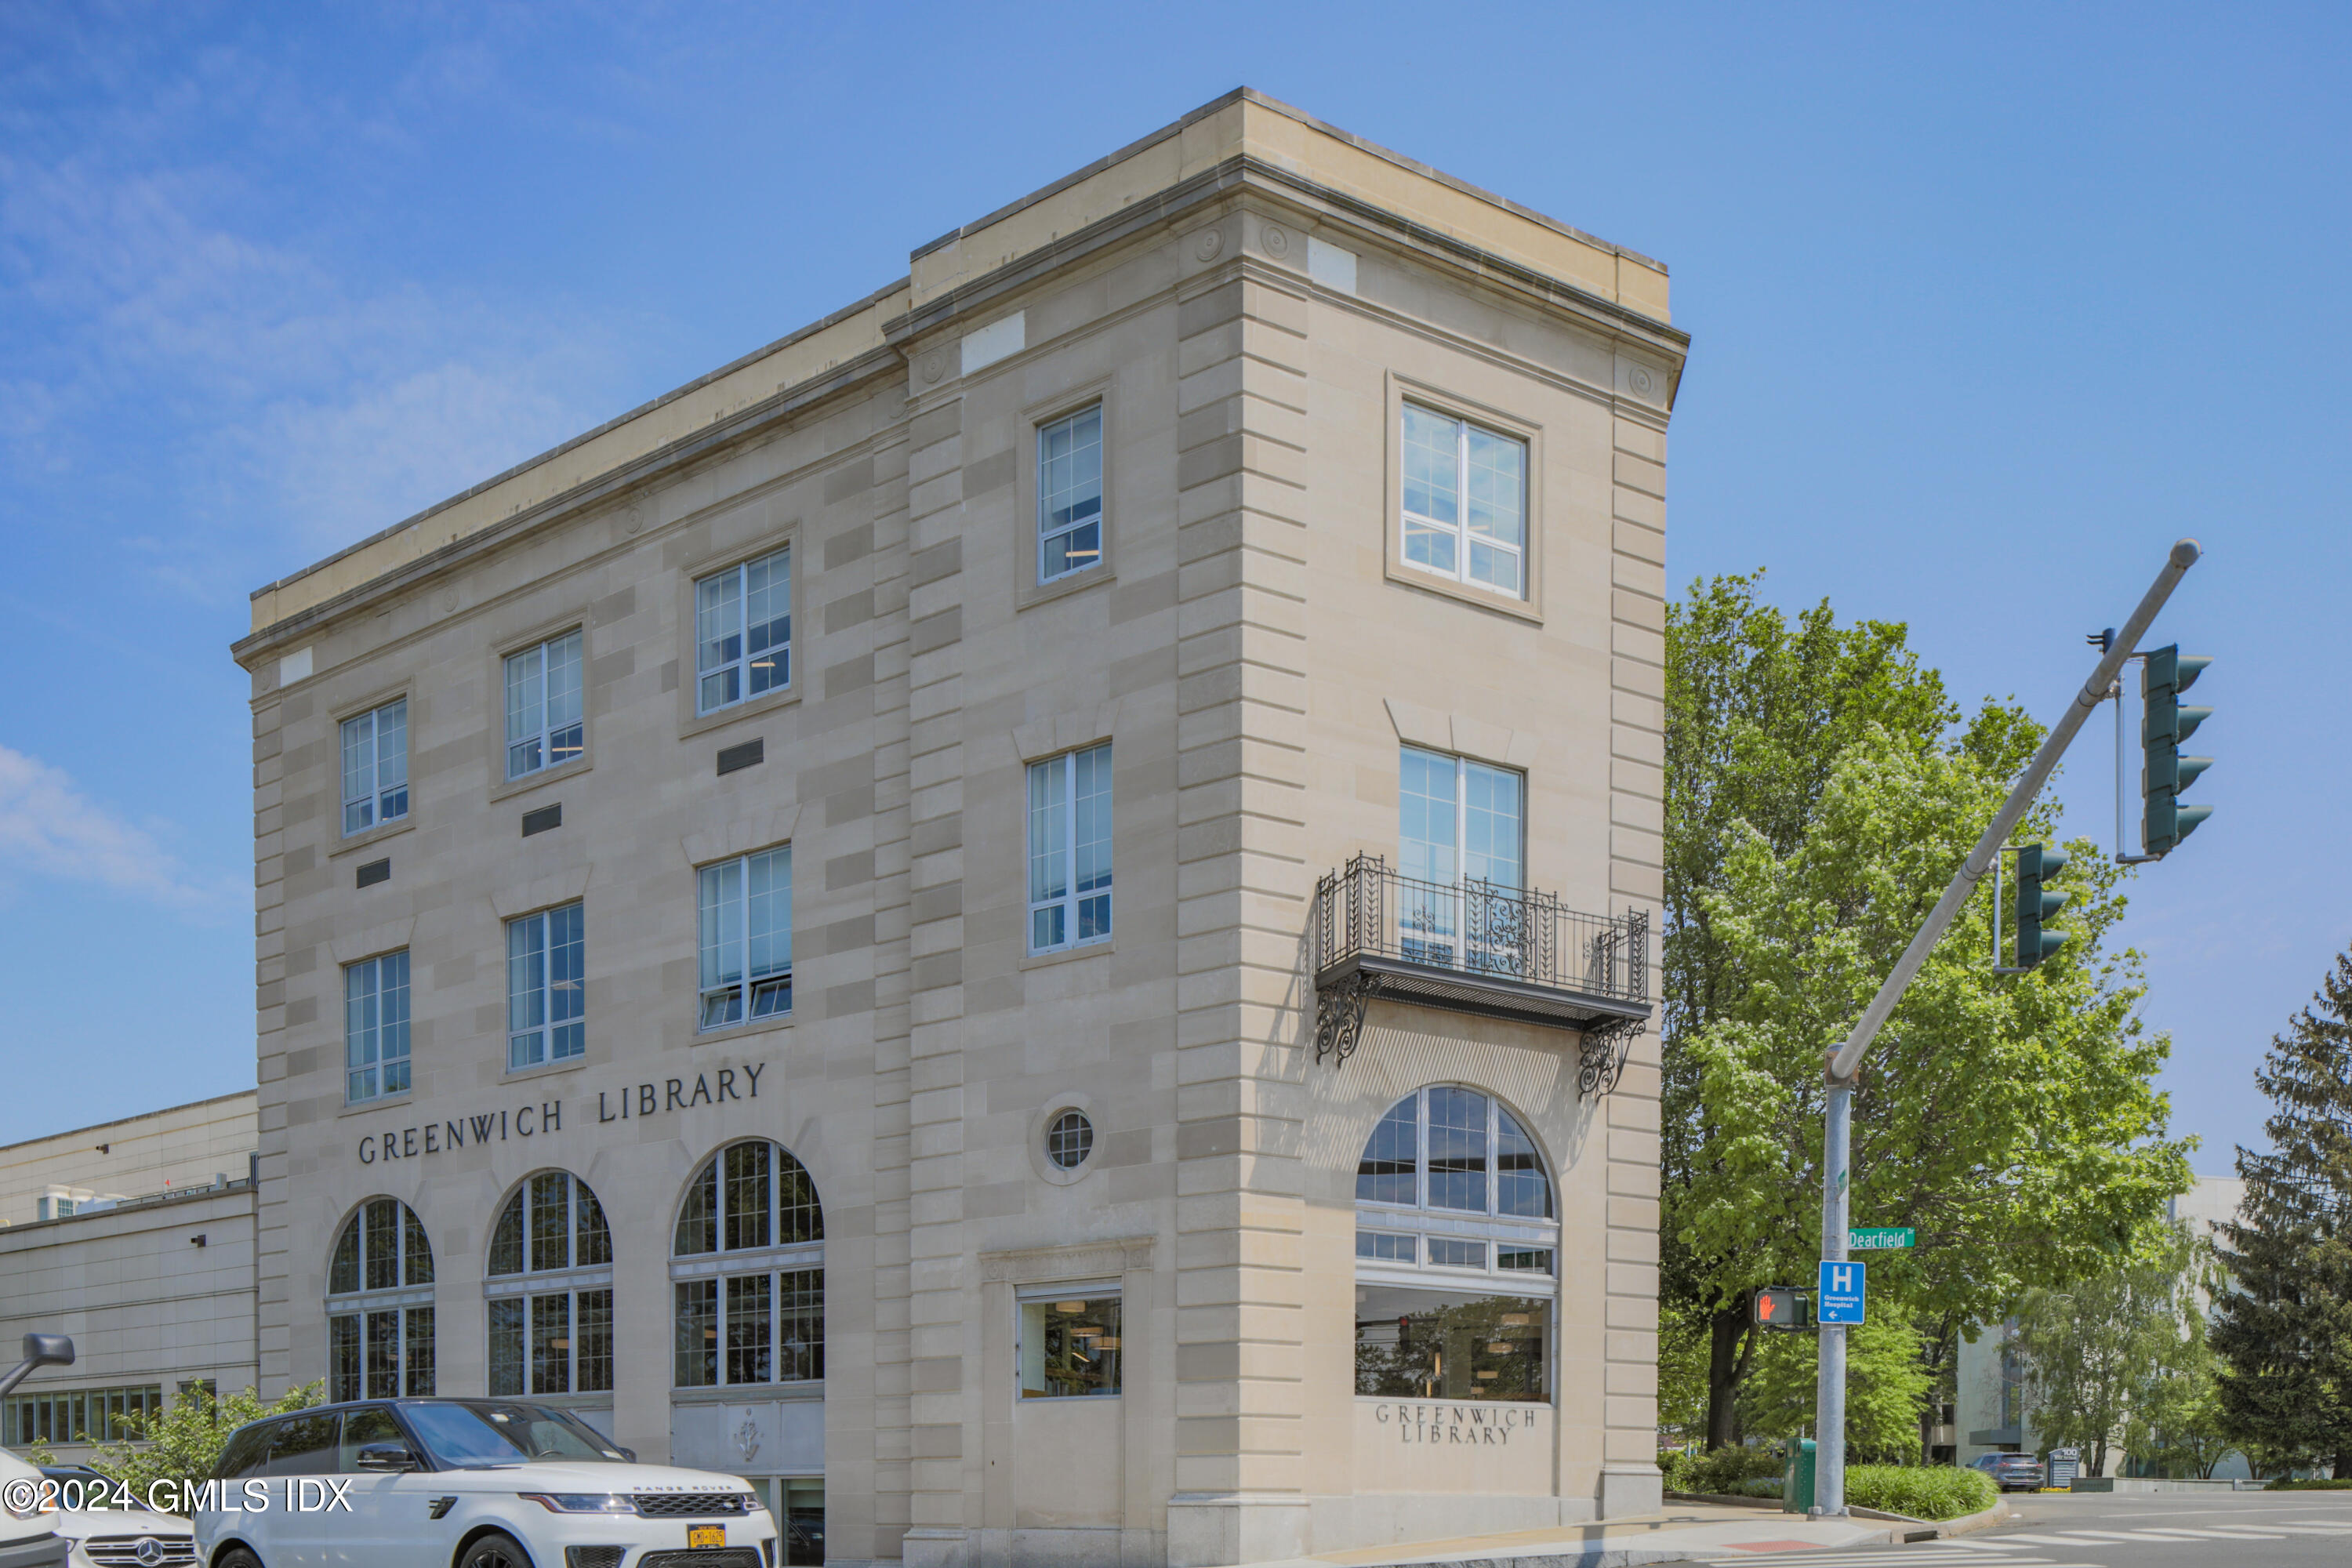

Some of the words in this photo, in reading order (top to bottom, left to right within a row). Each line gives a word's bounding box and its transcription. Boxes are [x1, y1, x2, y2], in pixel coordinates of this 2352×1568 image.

[358, 1100, 561, 1164] GREENWICH
[598, 1062, 766, 1123] LIBRARY
[1849, 1232, 1905, 1247] Dearfield
[1832, 1265, 1852, 1292] H
[1376, 1404, 1534, 1427] GREENWICH
[1402, 1424, 1511, 1444] LIBRARY
